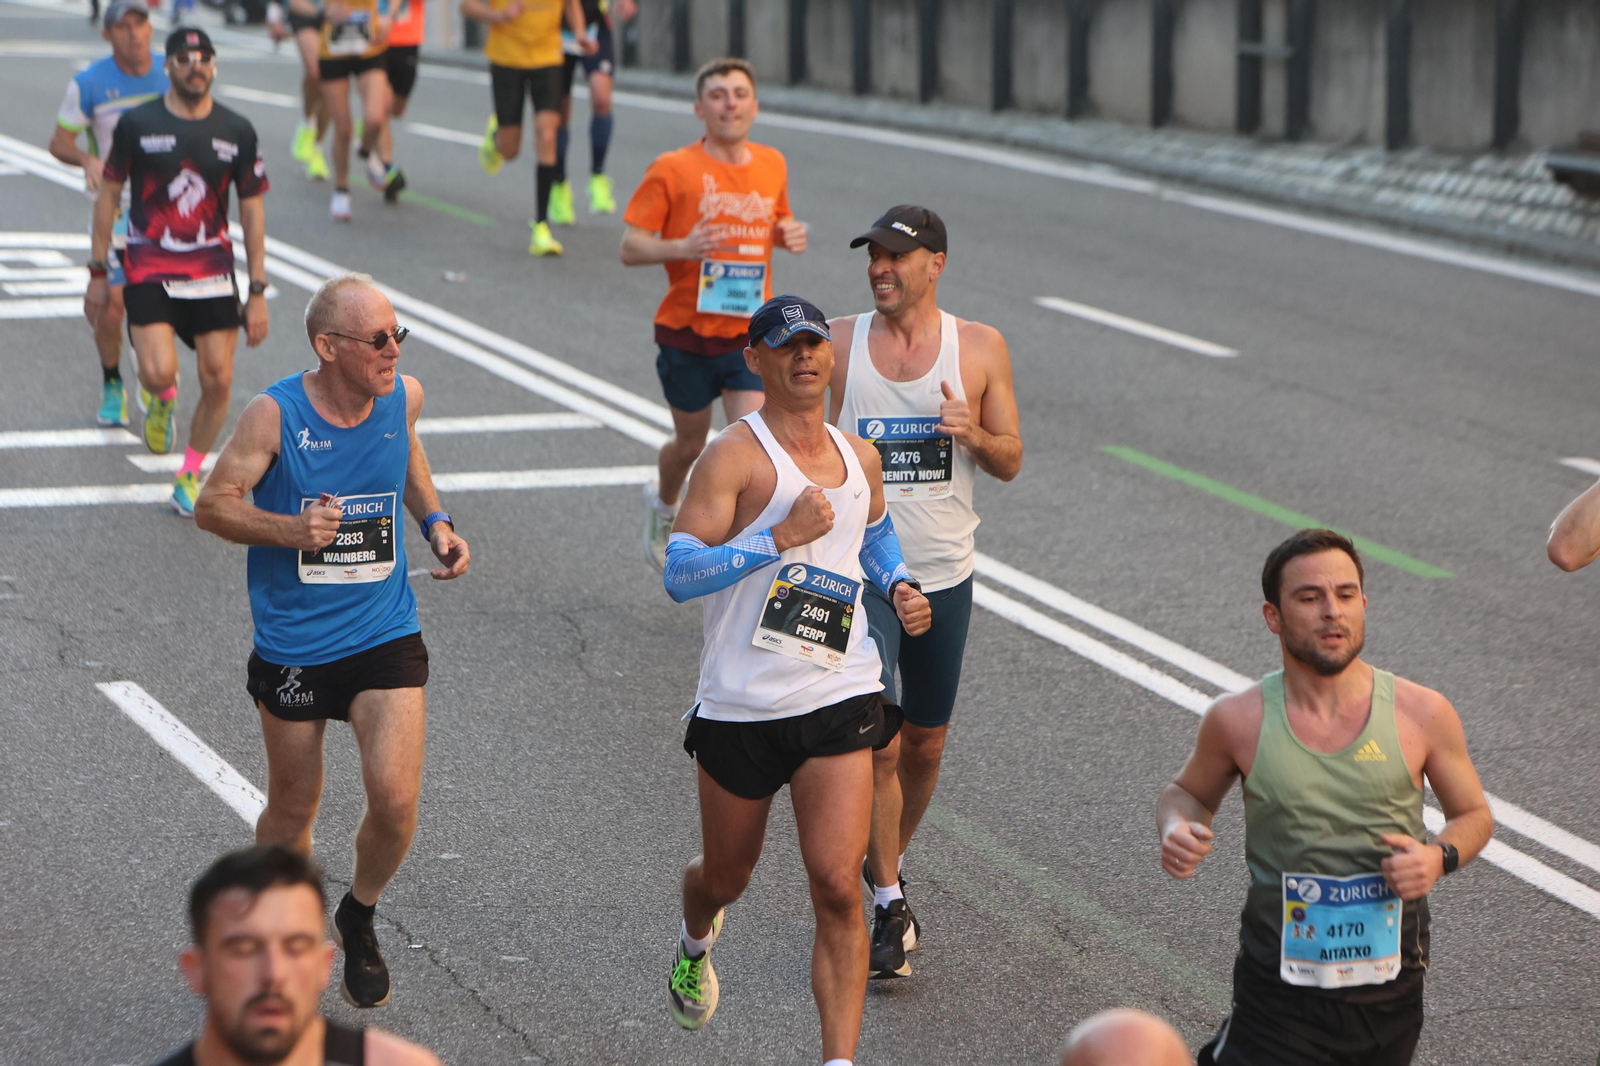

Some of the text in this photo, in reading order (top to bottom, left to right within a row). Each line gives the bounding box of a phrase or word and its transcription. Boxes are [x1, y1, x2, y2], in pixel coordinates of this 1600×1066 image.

[891, 451, 921, 464] 2476
[882, 469, 945, 482] RENITY NOW!
[341, 502, 383, 515] ZURICH
[336, 531, 363, 546] 2833
[323, 550, 376, 563] WAINBERG
[694, 562, 729, 581] ZURICH
[811, 574, 852, 597] ZURICH
[801, 603, 830, 623] 2491
[796, 624, 827, 643] PERPI
[1329, 884, 1388, 902] ZURICH
[1326, 922, 1365, 939] 4170
[1320, 945, 1371, 961] AITATXO
